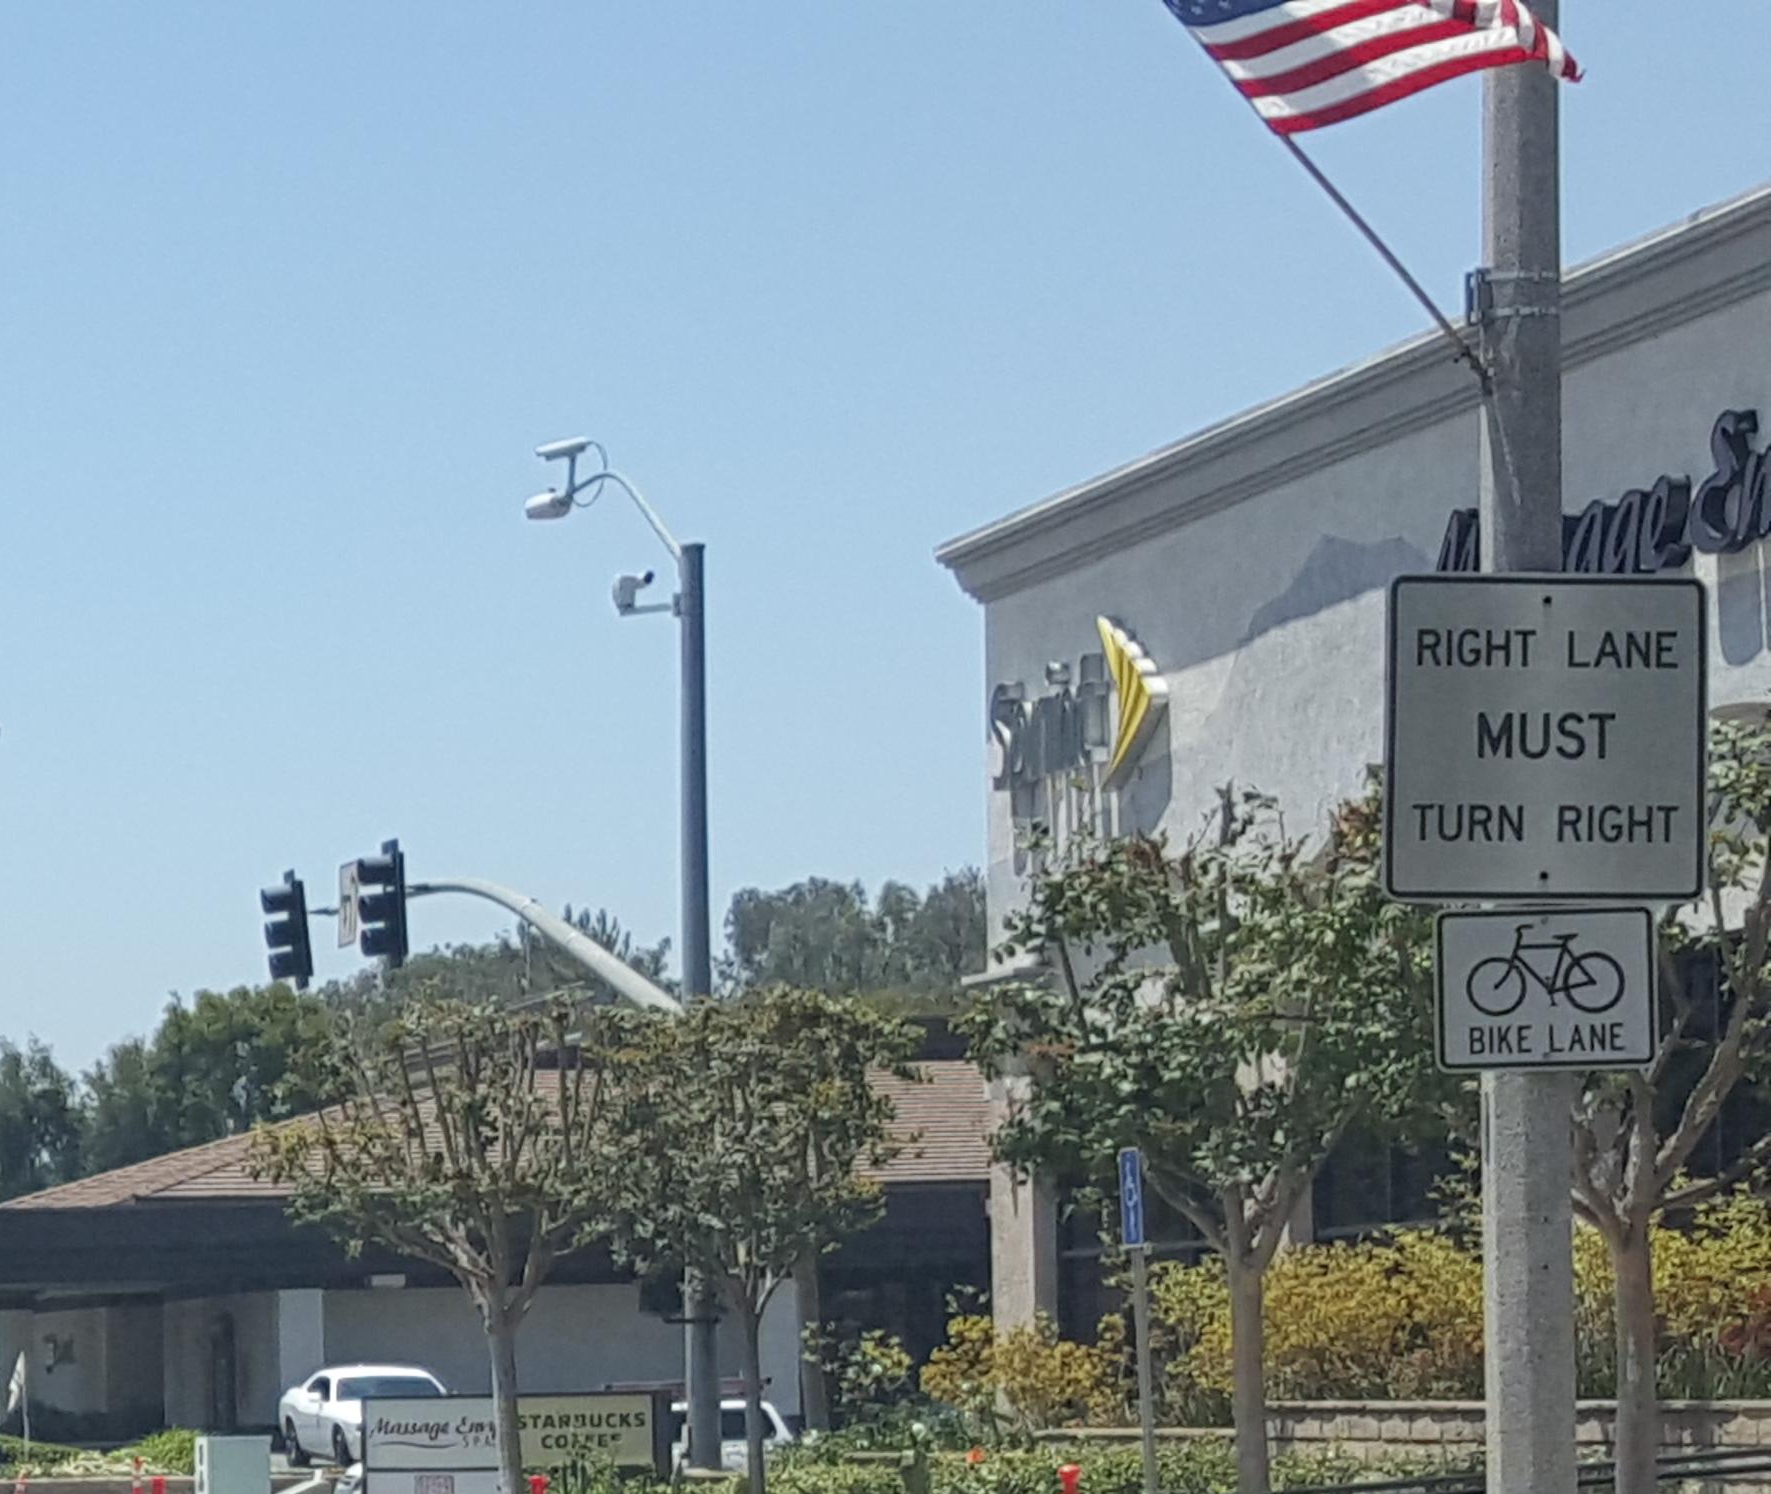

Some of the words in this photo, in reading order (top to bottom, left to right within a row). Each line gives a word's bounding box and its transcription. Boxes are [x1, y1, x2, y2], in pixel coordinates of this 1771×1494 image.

[1416, 629, 1536, 667] RIGHT
[1567, 630, 1678, 669] LANE
[1477, 712, 1616, 760] MUST
[1412, 803, 1524, 842] TURN
[1557, 804, 1679, 843] RIGHT
[1469, 1024, 1532, 1055] BIKE
[1549, 1022, 1626, 1053] LANE
[370, 1418, 450, 1440] Massage
[518, 1412, 646, 1429] STARBUCKS
